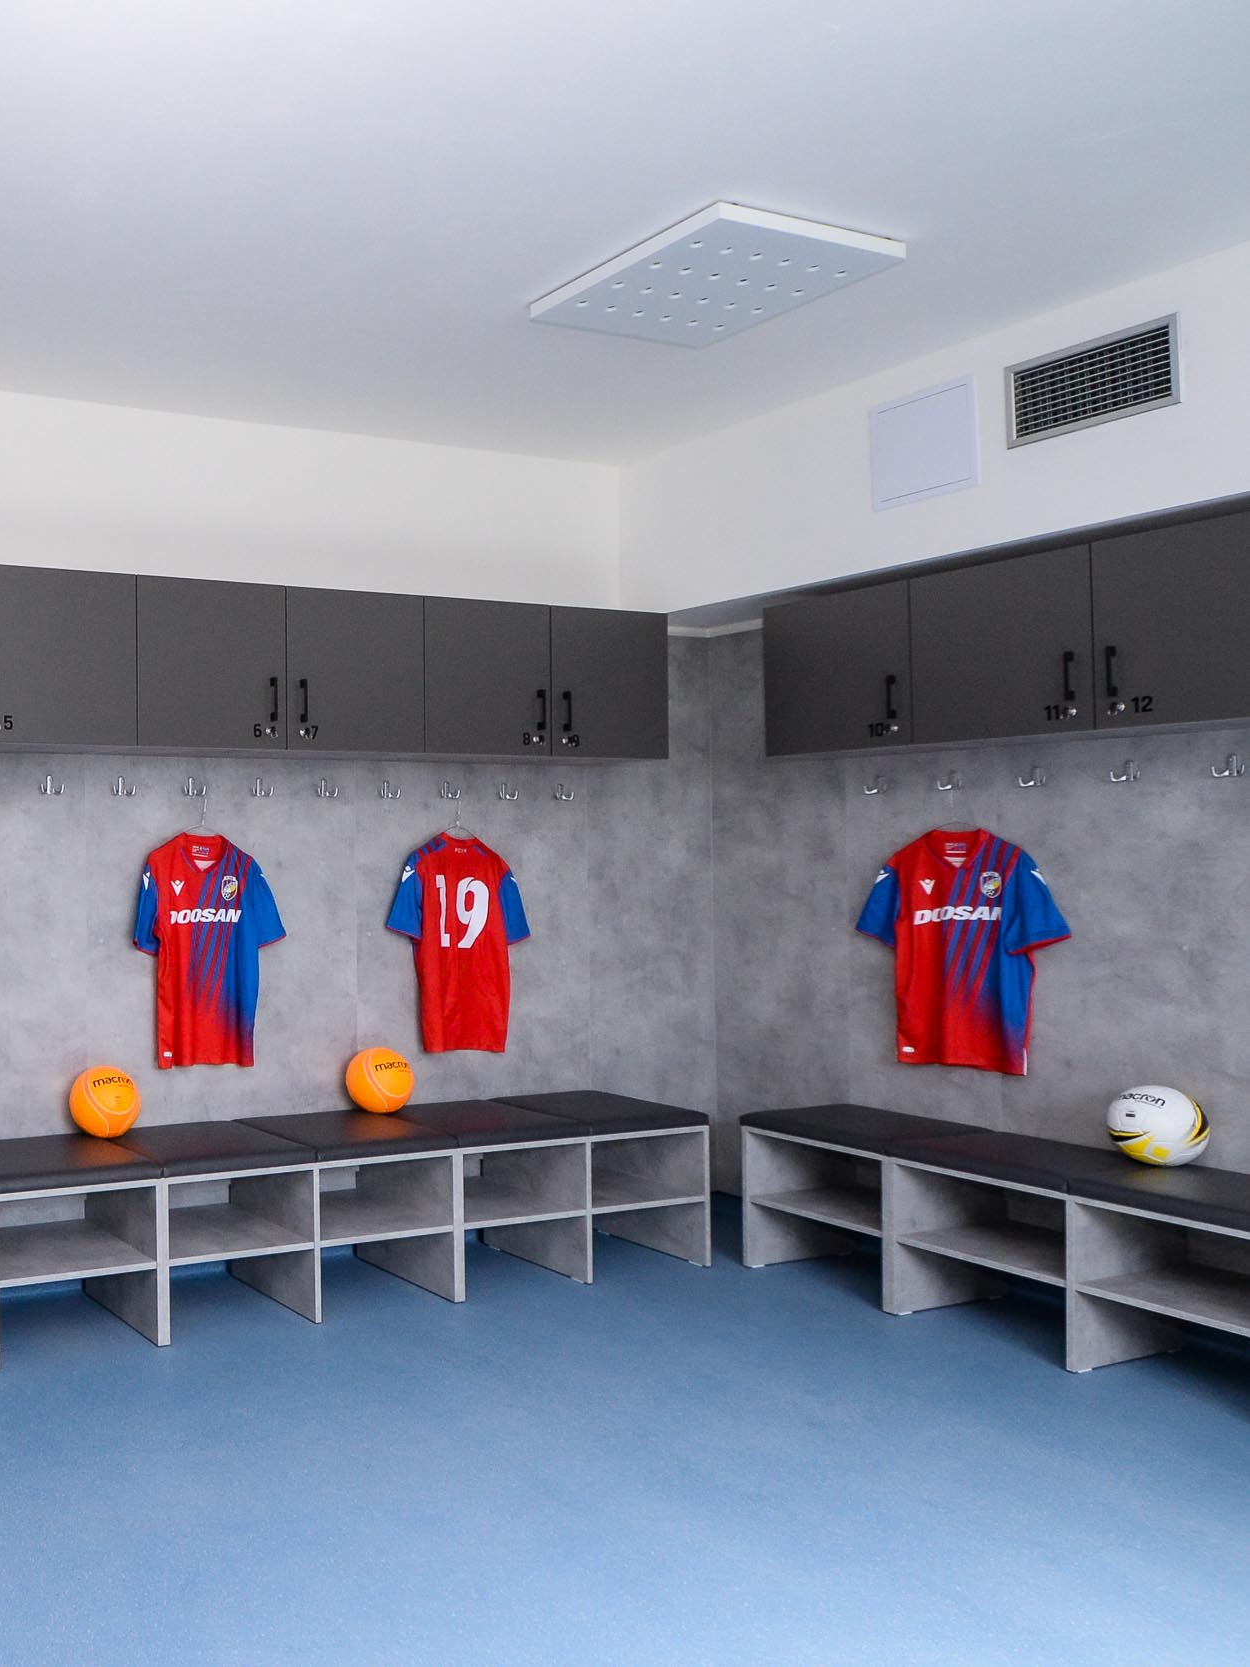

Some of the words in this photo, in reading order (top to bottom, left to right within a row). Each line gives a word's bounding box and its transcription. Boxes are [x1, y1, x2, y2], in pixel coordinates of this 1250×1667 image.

[1132, 696, 1153, 713] 12
[1045, 705, 1060, 721] 11
[4, 715, 13, 730] 5
[253, 723, 262, 738] 6
[310, 725, 318, 740] 7
[523, 732, 530, 746] 8
[435, 874, 489, 949] 19
